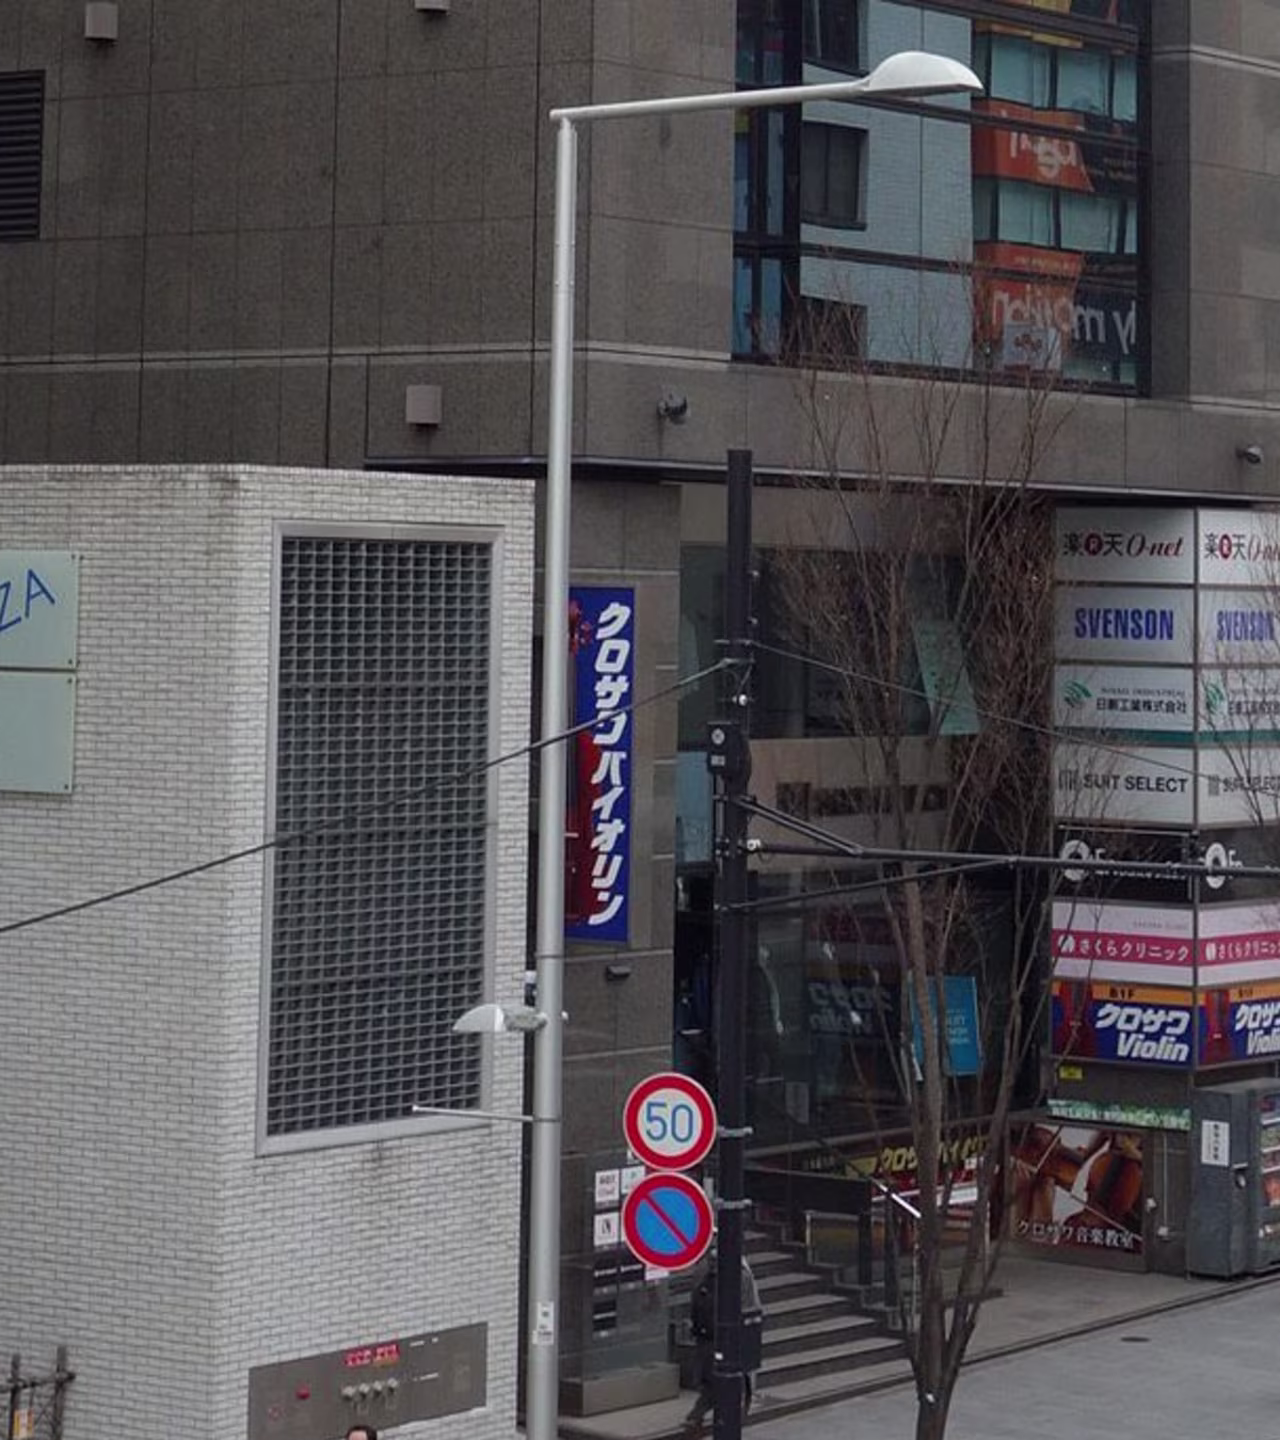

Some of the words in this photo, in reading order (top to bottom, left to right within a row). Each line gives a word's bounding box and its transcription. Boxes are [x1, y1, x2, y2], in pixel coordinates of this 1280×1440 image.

[1074, 607, 1174, 640] SVENSON
[1216, 610, 1275, 641] SVENSON
[587, 602, 632, 925] クロサワバイオリン
[1125, 775, 1189, 793] SELECT
[1079, 940, 1190, 961] さくらクリニック
[1095, 1002, 1190, 1035] クロサワ
[1118, 1032, 1190, 1062] Violin
[645, 1101, 694, 1143] 50
